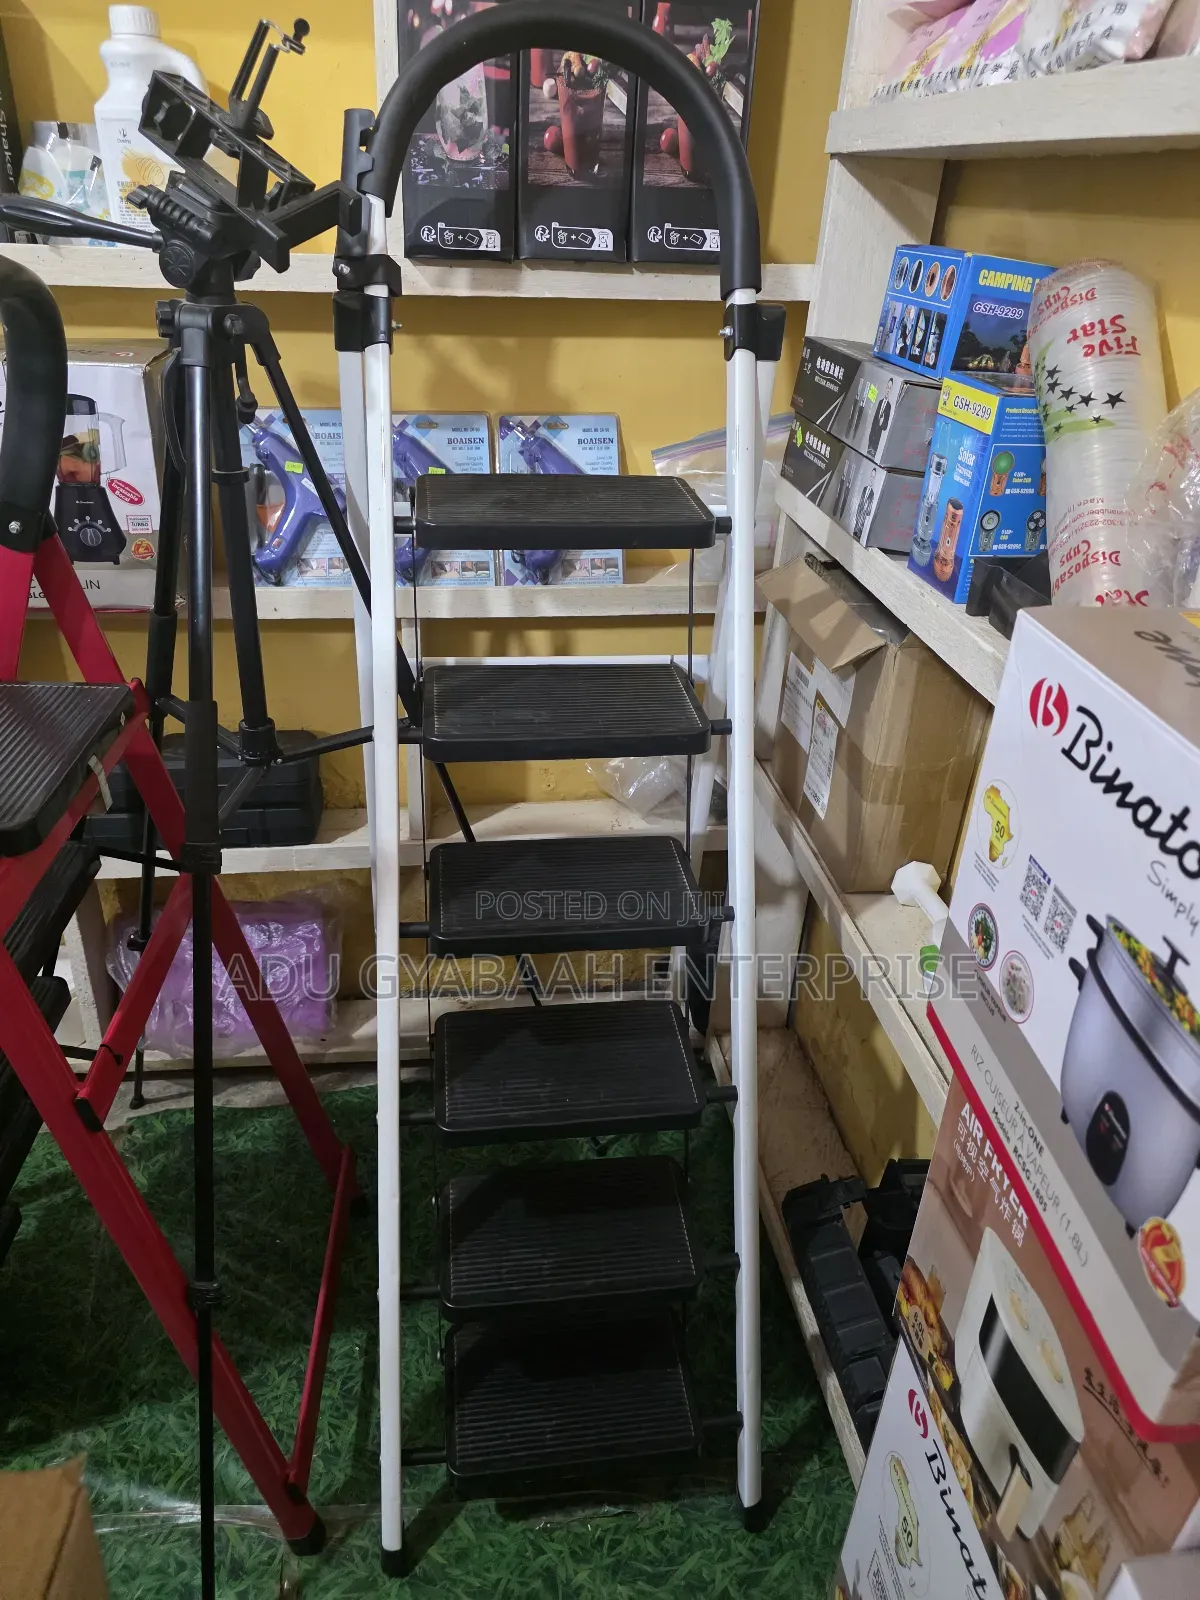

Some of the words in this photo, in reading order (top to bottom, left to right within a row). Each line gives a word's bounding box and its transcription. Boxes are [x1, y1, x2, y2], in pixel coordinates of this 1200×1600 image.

[979, 269, 1033, 293] CAMPING
[973, 301, 1024, 319] GSH-9299
[1037, 286, 1070, 316] Cups
[1067, 314, 1127, 344] Star
[1082, 336, 1141, 358] Five
[953, 395, 992, 420] GSH-9299
[958, 447, 975, 466] Solar
[112, 482, 138, 501] Incassable
[115, 490, 130, 502] Bocal
[1078, 497, 1105, 507] Made
[1060, 540, 1090, 568] Cups
[995, 820, 1004, 838] 50
[1147, 861, 1200, 937] Simply
[961, 1102, 983, 1146] AIR
[1014, 1101, 1044, 1157] 2-in-ONE
[971, 1044, 982, 1073] RIZ
[983, 1069, 1018, 1130] CUISEUR
[1026, 1144, 1060, 1211] VAPEUR
[1060, 1211, 1089, 1267] (1.8L)
[957, 1118, 1025, 1248] 可视空气炸锅
[901, 1515, 913, 1548] 50
